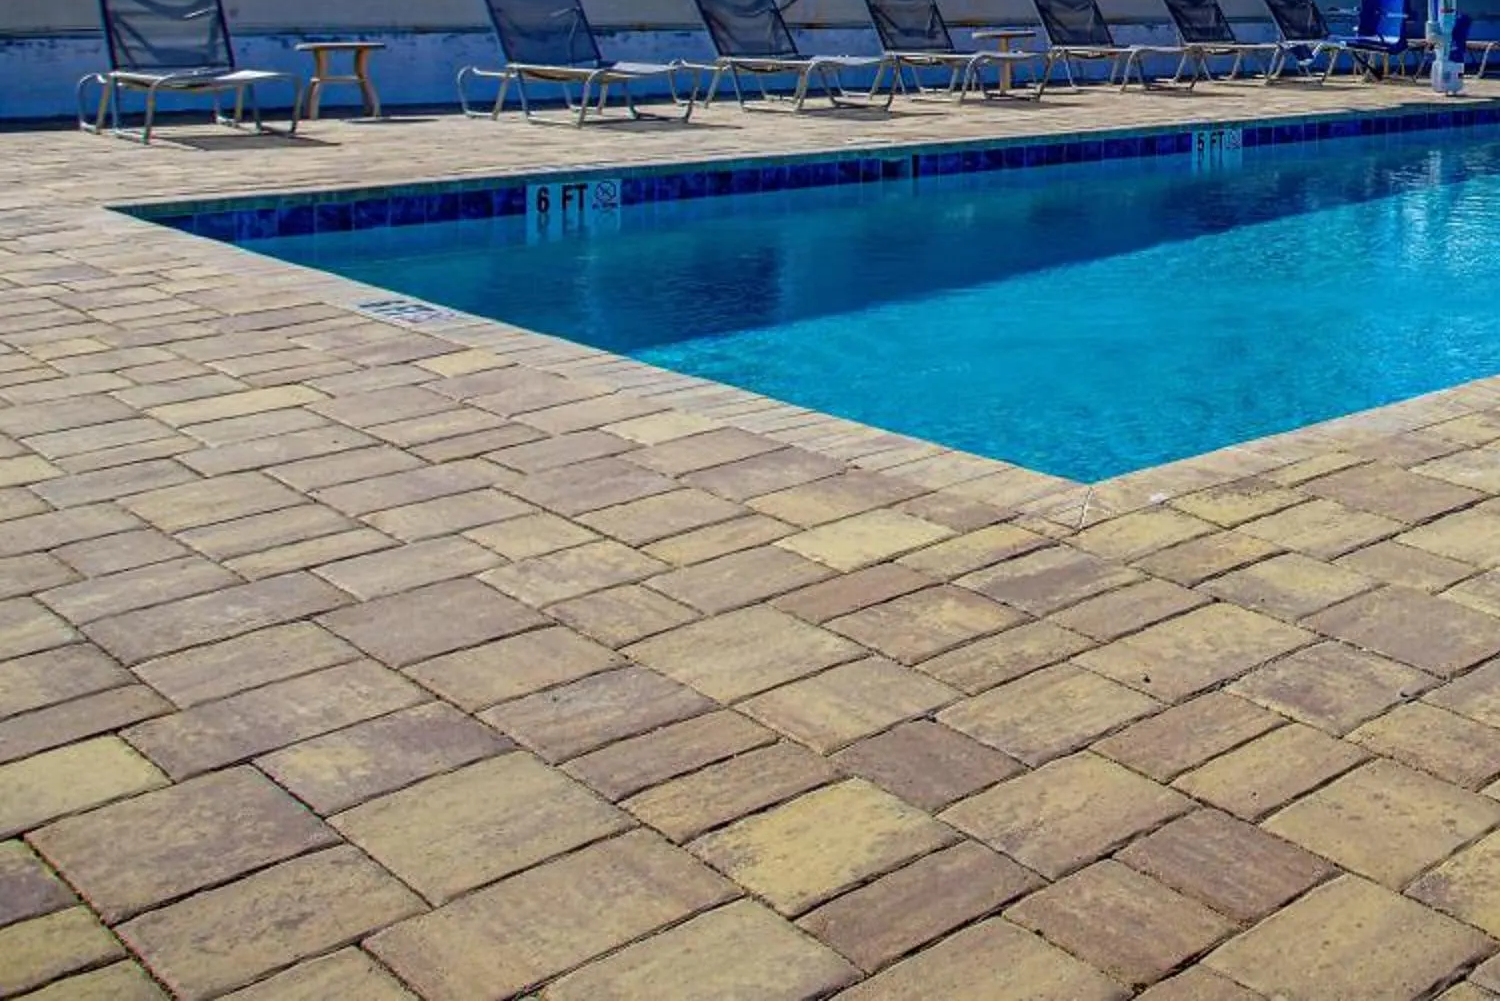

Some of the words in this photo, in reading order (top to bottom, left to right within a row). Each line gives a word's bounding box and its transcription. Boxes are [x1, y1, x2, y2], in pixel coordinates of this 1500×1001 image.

[1210, 130, 1224, 150] FT
[536, 186, 549, 213] 6
[561, 183, 588, 211] FT
